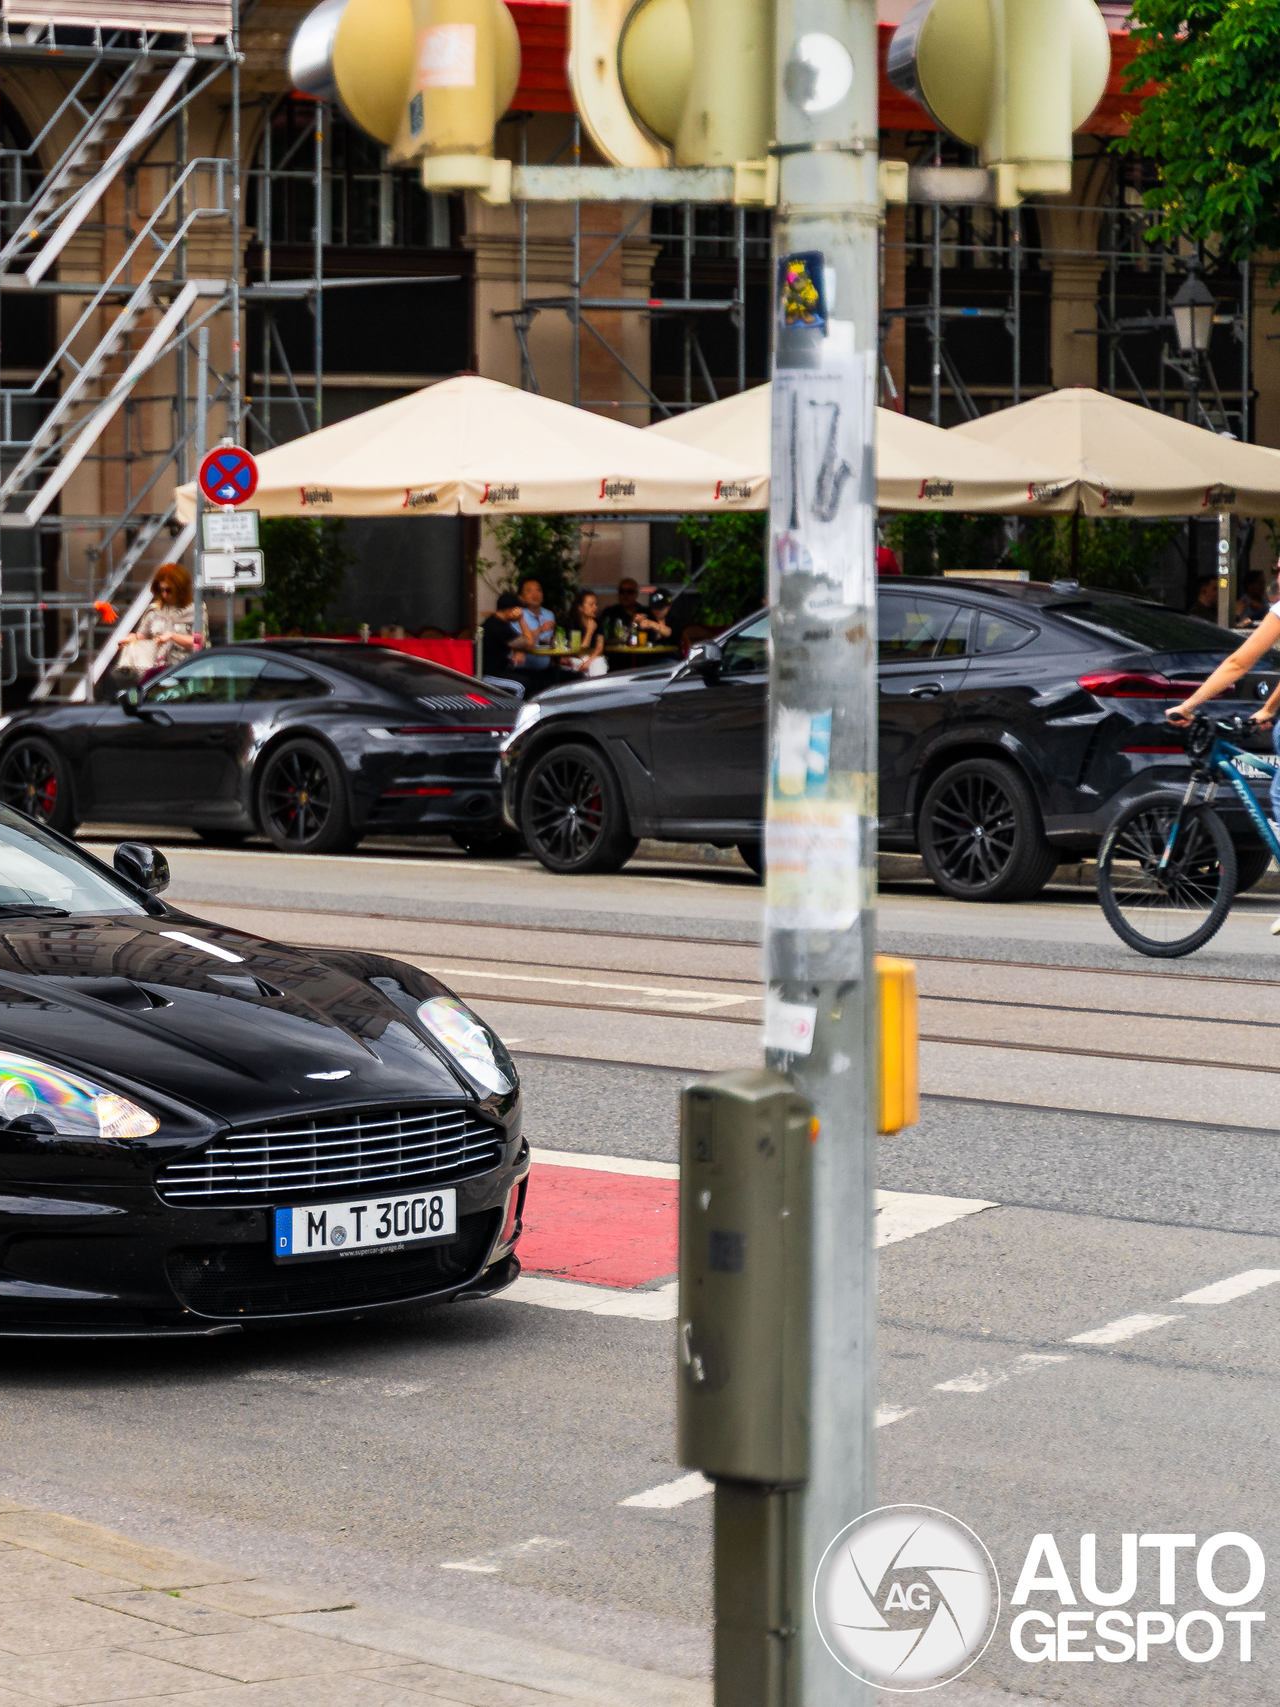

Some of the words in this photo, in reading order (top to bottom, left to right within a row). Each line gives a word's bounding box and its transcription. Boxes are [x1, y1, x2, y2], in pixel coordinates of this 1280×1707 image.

[307, 1210, 327, 1247] M
[350, 1205, 368, 1242] T
[375, 1195, 444, 1239] 3008
[279, 1237, 287, 1248] D
[339, 1243, 405, 1257] www.supercar-garage.de
